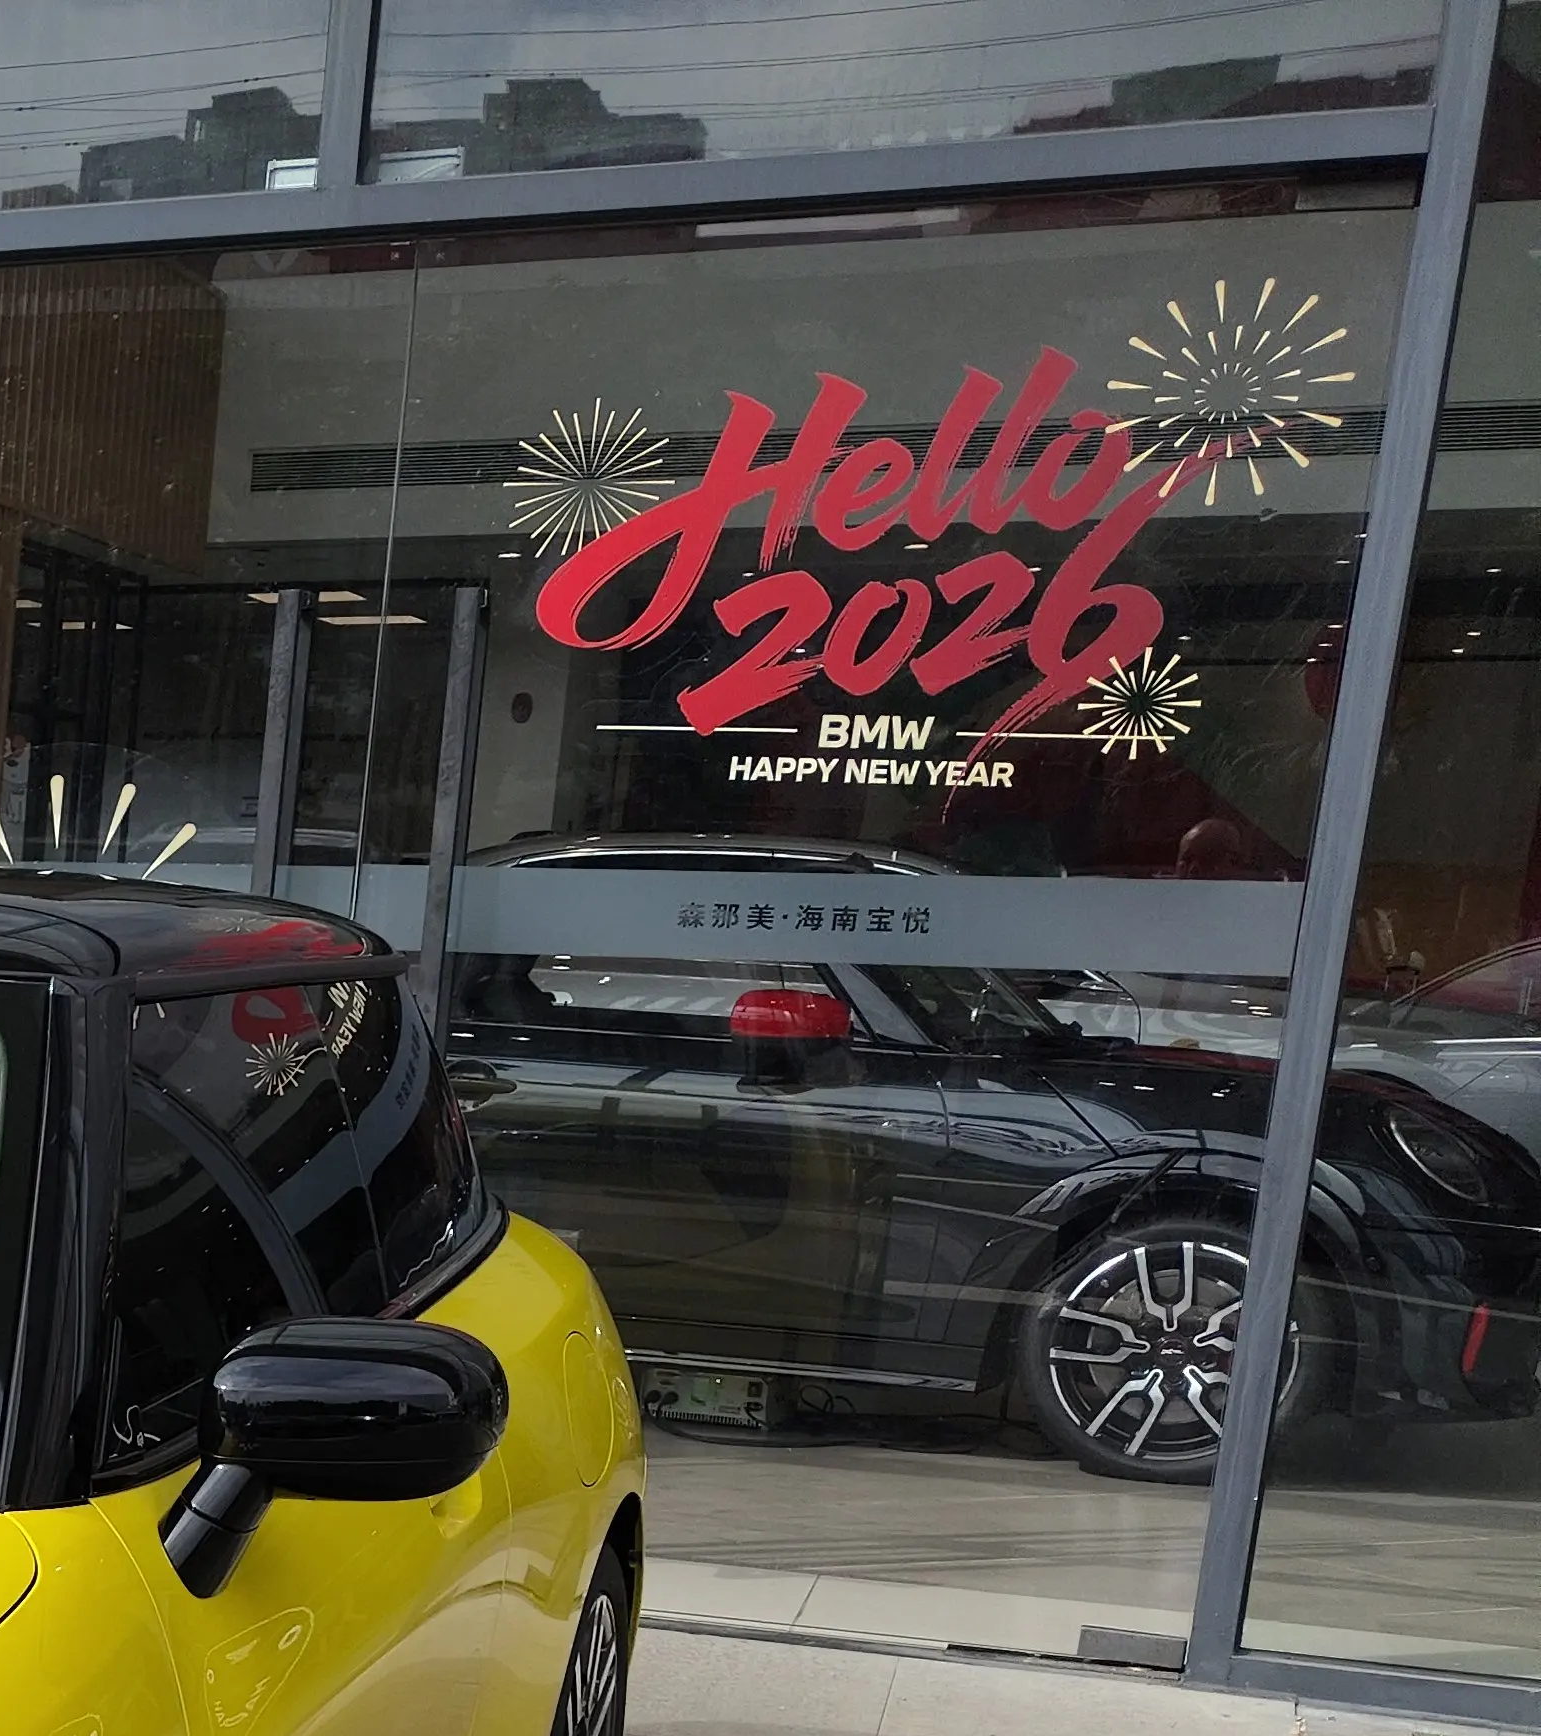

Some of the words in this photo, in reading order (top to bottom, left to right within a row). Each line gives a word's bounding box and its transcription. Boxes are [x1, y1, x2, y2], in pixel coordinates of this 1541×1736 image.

[535, 345, 1133, 651] Hello
[675, 465, 1175, 735] 2026
[818, 715, 935, 752] BMW
[728, 755, 840, 786] HAPPY
[843, 757, 918, 787] NEW
[924, 759, 1014, 790] YEAR
[676, 902, 931, 935] 森那美·海南宝悦
